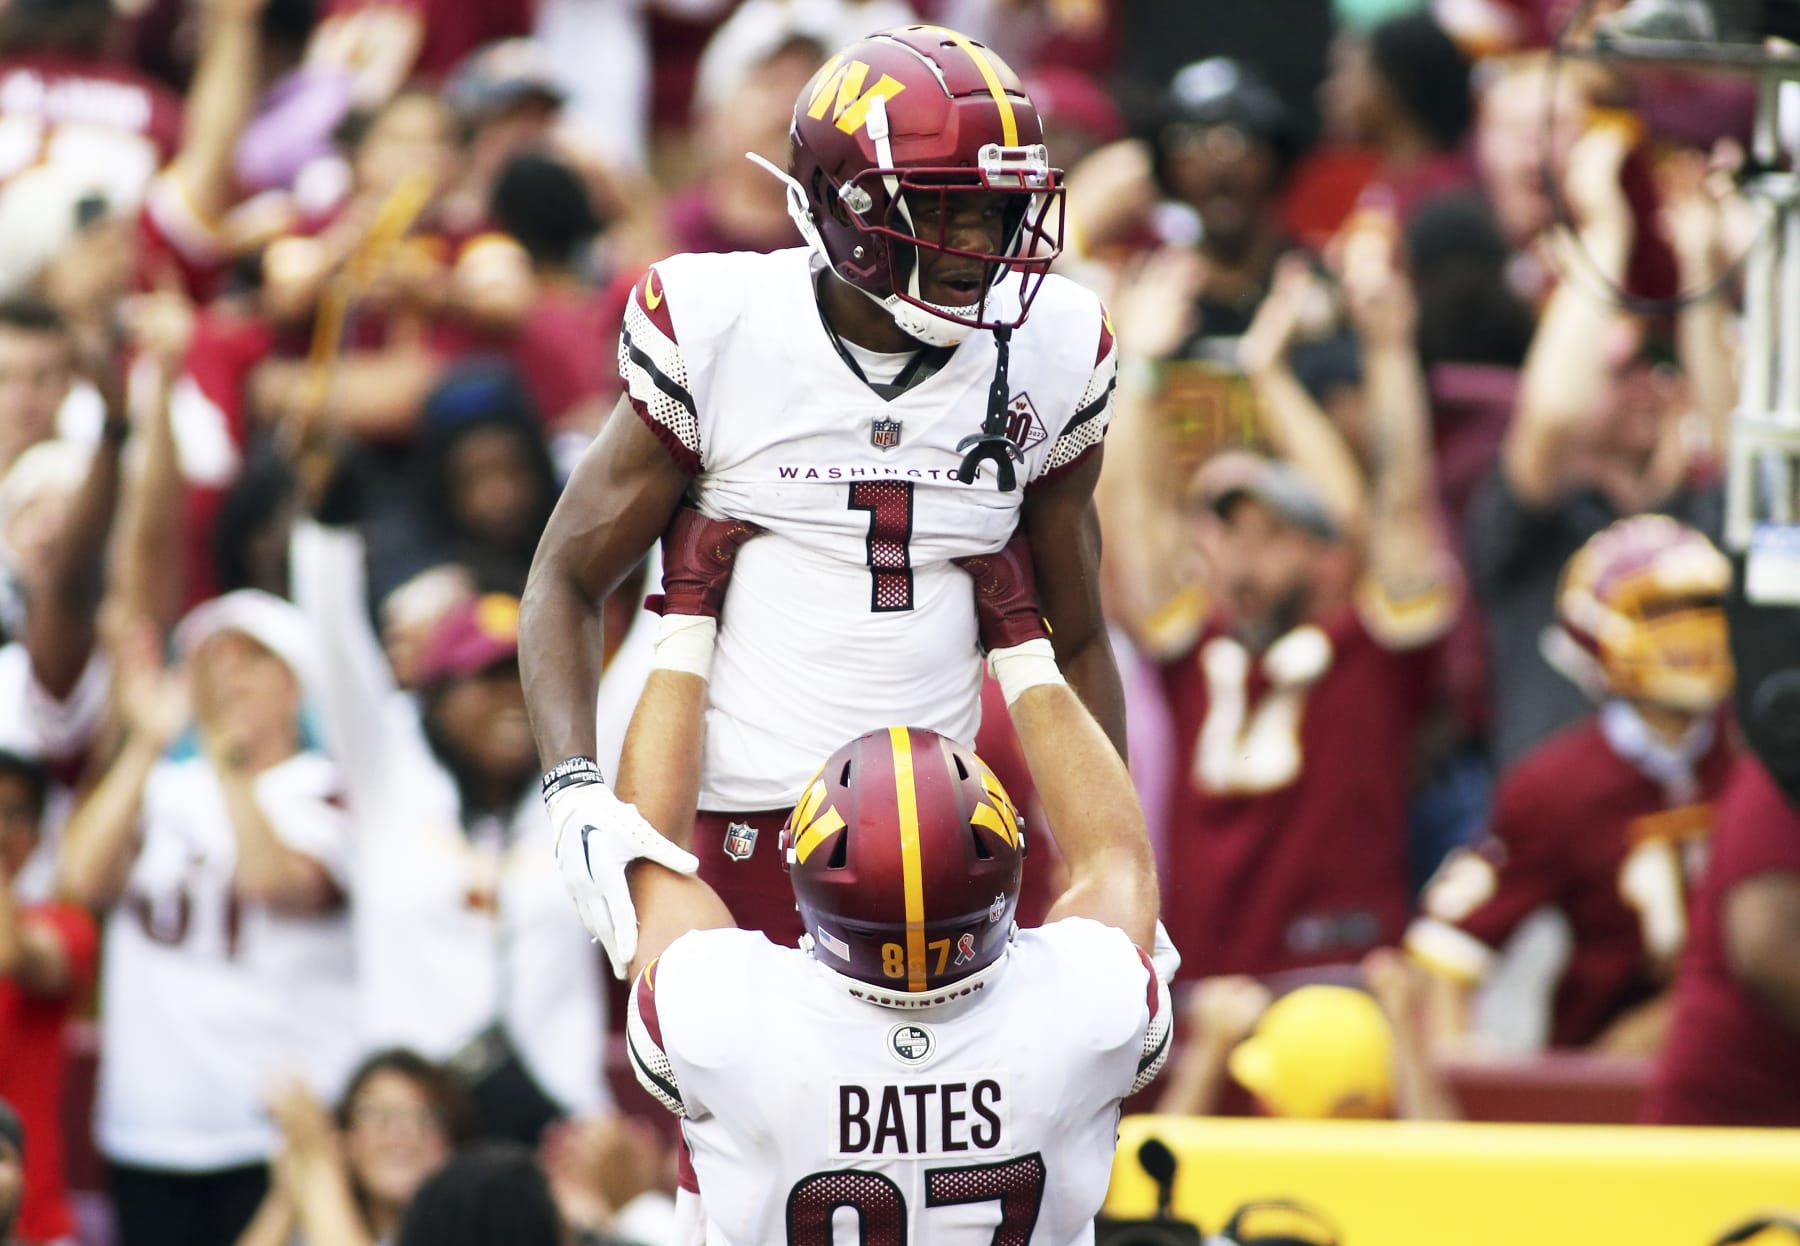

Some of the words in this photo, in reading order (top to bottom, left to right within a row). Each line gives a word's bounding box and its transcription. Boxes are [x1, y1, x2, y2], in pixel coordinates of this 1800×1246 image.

[875, 431, 896, 446] NFL
[847, 479, 915, 612] 1
[881, 938, 951, 978] 87
[849, 982, 984, 1007] WASHINGTON
[839, 1079, 1002, 1154] BATES
